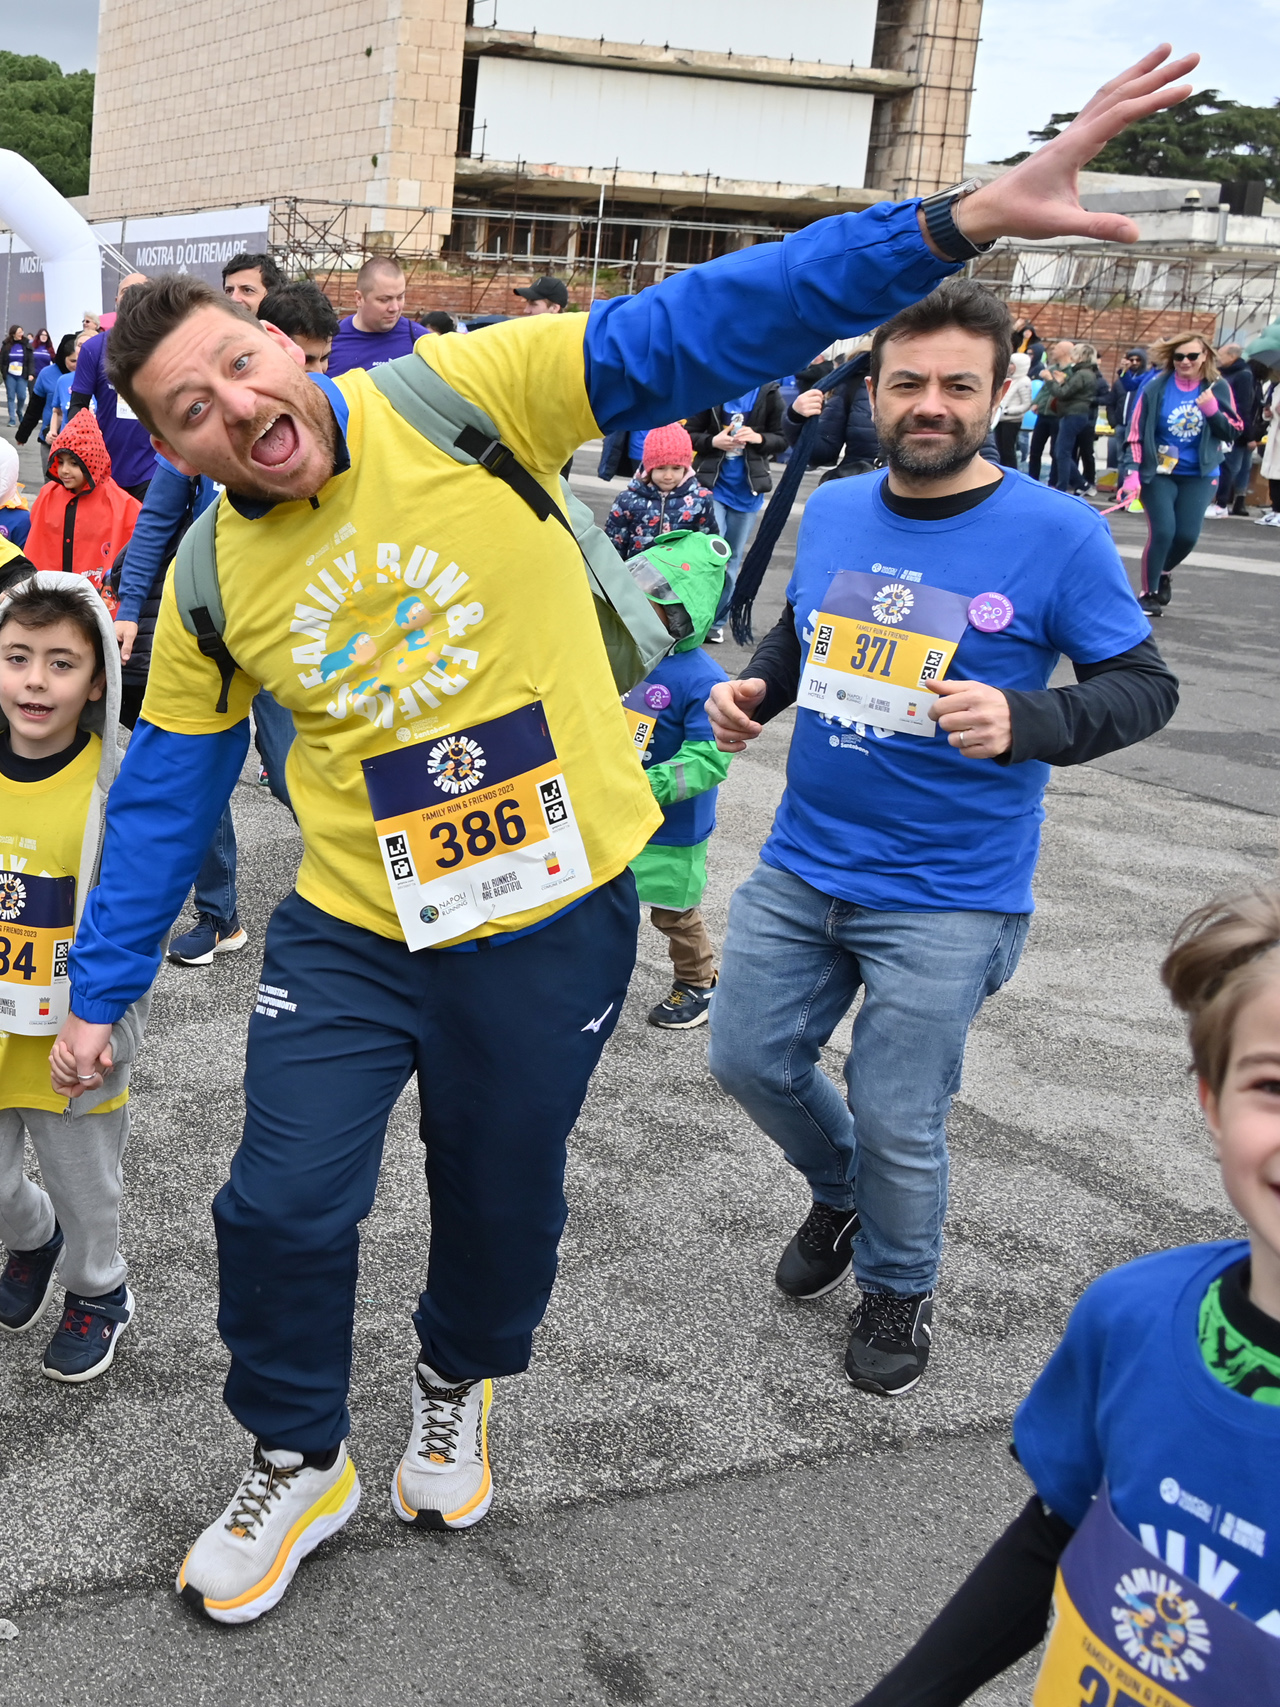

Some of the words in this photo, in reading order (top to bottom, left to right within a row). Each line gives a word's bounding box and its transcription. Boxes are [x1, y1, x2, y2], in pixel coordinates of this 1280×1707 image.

[136, 246, 172, 267] MOSTRA
[873, 584, 905, 602] FAMILY
[902, 588, 914, 607] RUN
[289, 549, 363, 689] FAMILY
[376, 543, 470, 607] RUN
[445, 601, 484, 638] &
[872, 604, 903, 625] FRIENDS
[901, 607, 911, 615] &
[856, 624, 873, 632] FAMILY
[888, 631, 909, 641] FRIENDS
[850, 633, 898, 677] 371
[326, 644, 479, 729] FRIENDS
[808, 692, 825, 700] HOTELS
[847, 693, 863, 701] NAPOLI
[427, 736, 456, 774] FAMILY
[459, 736, 484, 759] RUN
[474, 758, 486, 769] &
[433, 769, 484, 794] FRIENDS
[422, 808, 446, 822] FAMILY
[447, 803, 462, 814] RUN
[462, 800, 468, 808] &
[468, 790, 498, 806] FRIENDS
[498, 783, 515, 796] 2023
[430, 798, 527, 869] 386
[13, 877, 27, 899] RUN
[482, 881, 491, 891] ALL
[491, 871, 518, 888] RUNNERS
[482, 890, 493, 901] ARE
[493, 880, 523, 898] BEAUTIFUL
[17, 899, 26, 908] &
[439, 892, 467, 908] NAPOLI
[441, 900, 468, 916] RUNNING
[2, 925, 24, 936] FRIENDS
[24, 930, 37, 938] 2023
[1114, 1567, 1183, 1606] FAMILY
[1176, 1599, 1212, 1655] RUN
[1110, 1606, 1190, 1682] FRIENDS
[1081, 1636, 1114, 1674] FAMILY
[1115, 1668, 1142, 1693] RUN
[1181, 1649, 1206, 1672] &
